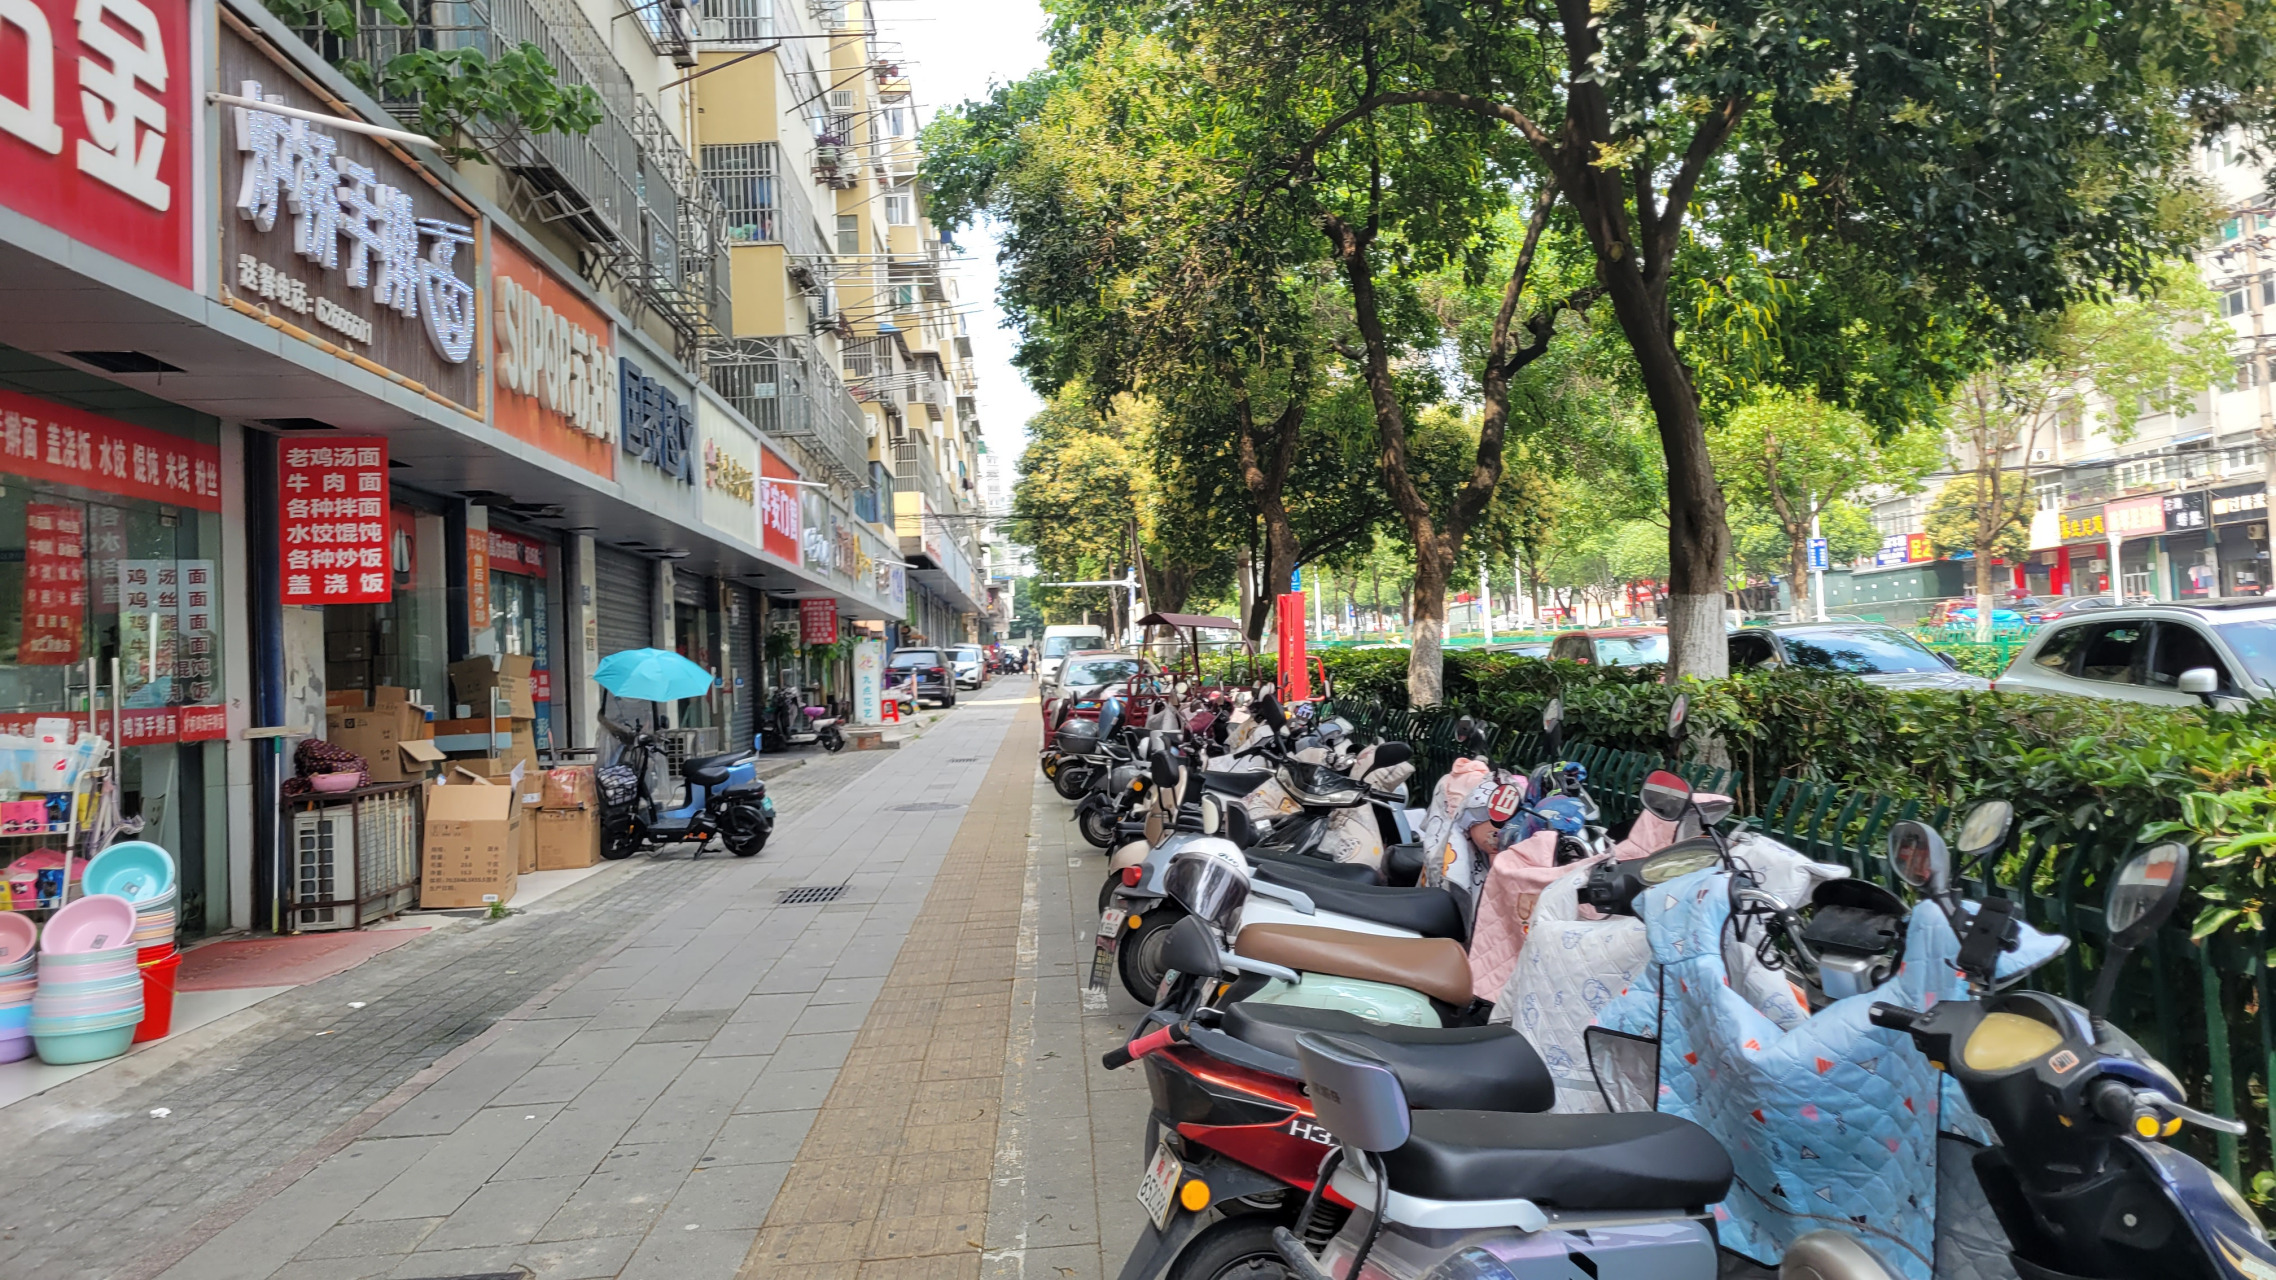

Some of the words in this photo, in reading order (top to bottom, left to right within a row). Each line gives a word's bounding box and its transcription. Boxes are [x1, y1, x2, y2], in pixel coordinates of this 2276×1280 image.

[494, 276, 572, 417] SUPOR
[571, 323, 618, 444] 苏泊尔
[0, 409, 38, 461] 擀面
[46, 422, 92, 471] 盖浇饭
[99, 435, 127, 479] 水饺
[133, 443, 160, 486] 馄饨
[165, 452, 190, 493] 米线
[195, 458, 218, 497] 粉丝
[286, 447, 381, 468] 老鸡汤面
[286, 473, 382, 492] 牛肉面
[287, 497, 381, 519] 各种拌面
[286, 523, 383, 544] 水饺馄饨
[287, 548, 384, 569] 各种炒饭
[127, 568, 207, 585] 鸡汤面
[287, 573, 385, 596] 盖浇饭
[128, 591, 208, 608] 鸡丝面
[1289, 1120, 1334, 1146] H3
